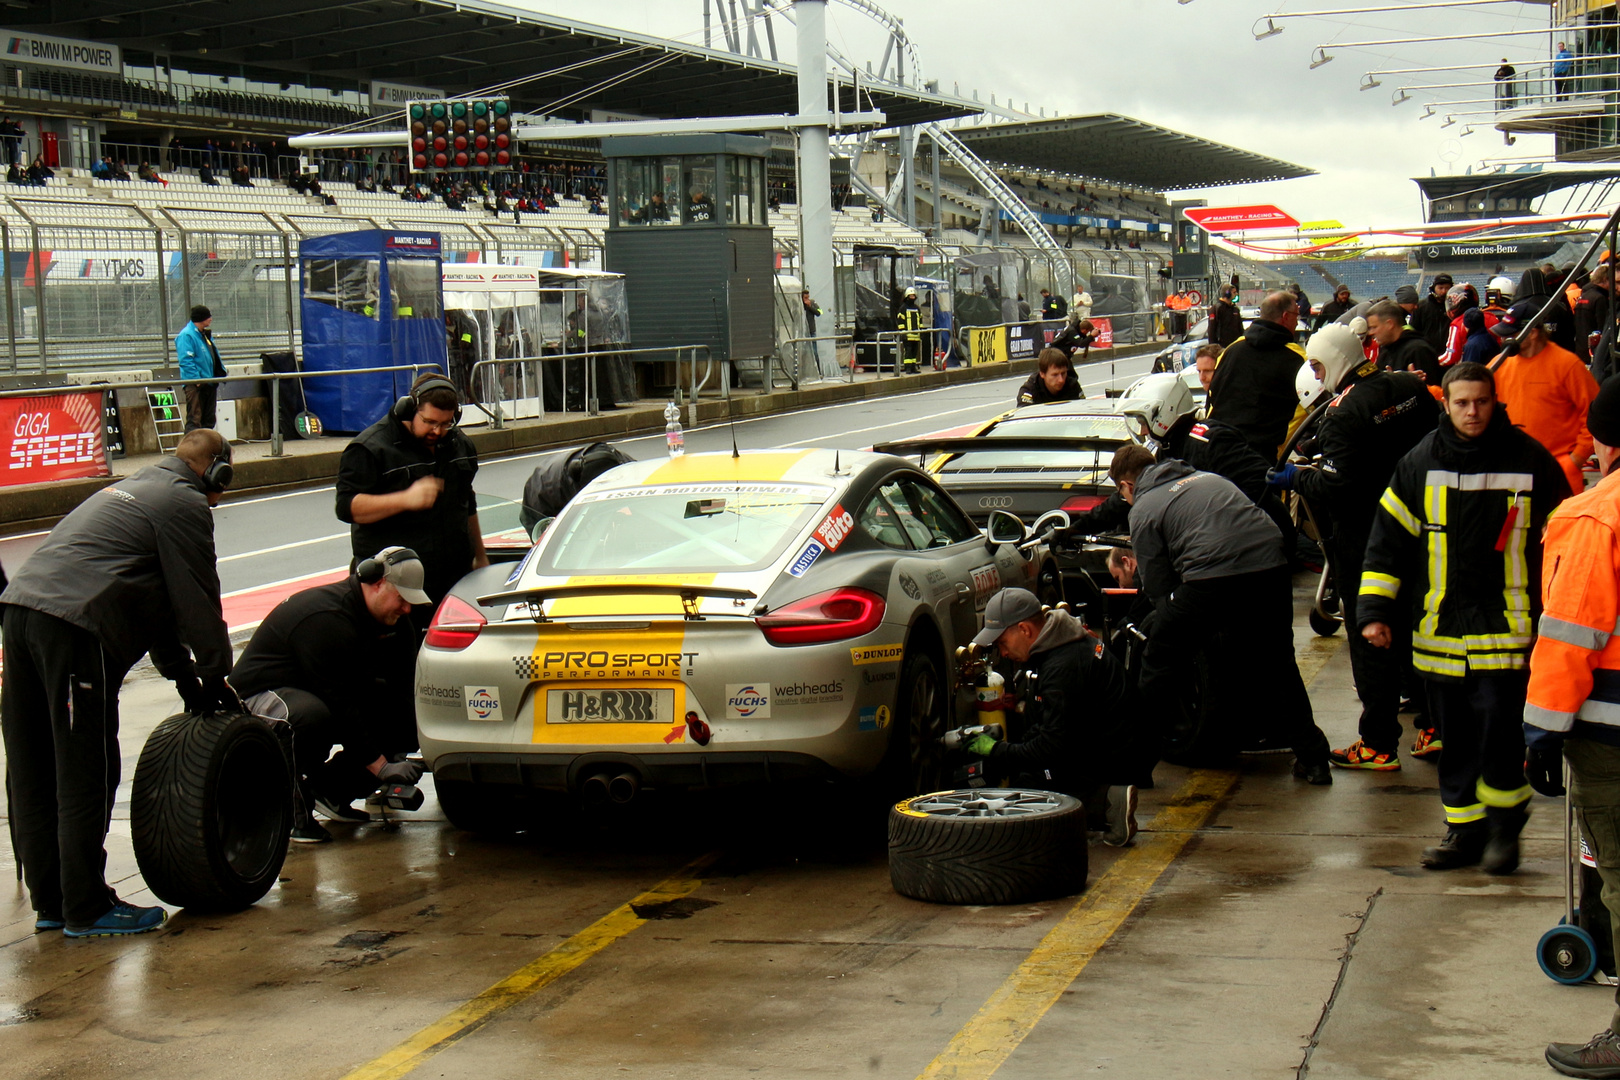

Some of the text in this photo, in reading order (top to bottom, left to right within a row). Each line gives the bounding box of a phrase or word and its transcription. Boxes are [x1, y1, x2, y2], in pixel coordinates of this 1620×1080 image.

[31, 40, 113, 67] BMW M POWER
[693, 211, 710, 223] 260
[394, 236, 432, 245] MANTHEY RACING
[1451, 245, 1518, 256] Mercedes-Benz
[977, 328, 996, 363] ADAC
[154, 393, 173, 406] 721
[14, 412, 51, 437] GIGA
[9, 432, 95, 469] SPEED
[605, 486, 800, 499] ESSEN MOTORSHOW.DE
[818, 515, 835, 537] sport
[824, 511, 854, 549] auto
[793, 546, 819, 574] BASTUCK
[543, 651, 699, 669] PRO SPORT
[863, 647, 903, 660] DUNLOP
[543, 669, 694, 678] PERFORMANCE
[420, 684, 461, 699] webheads
[775, 680, 843, 697] webheads
[468, 699, 499, 709] FUCHS
[562, 691, 654, 721] H&R
[728, 697, 768, 706] FUCHS
